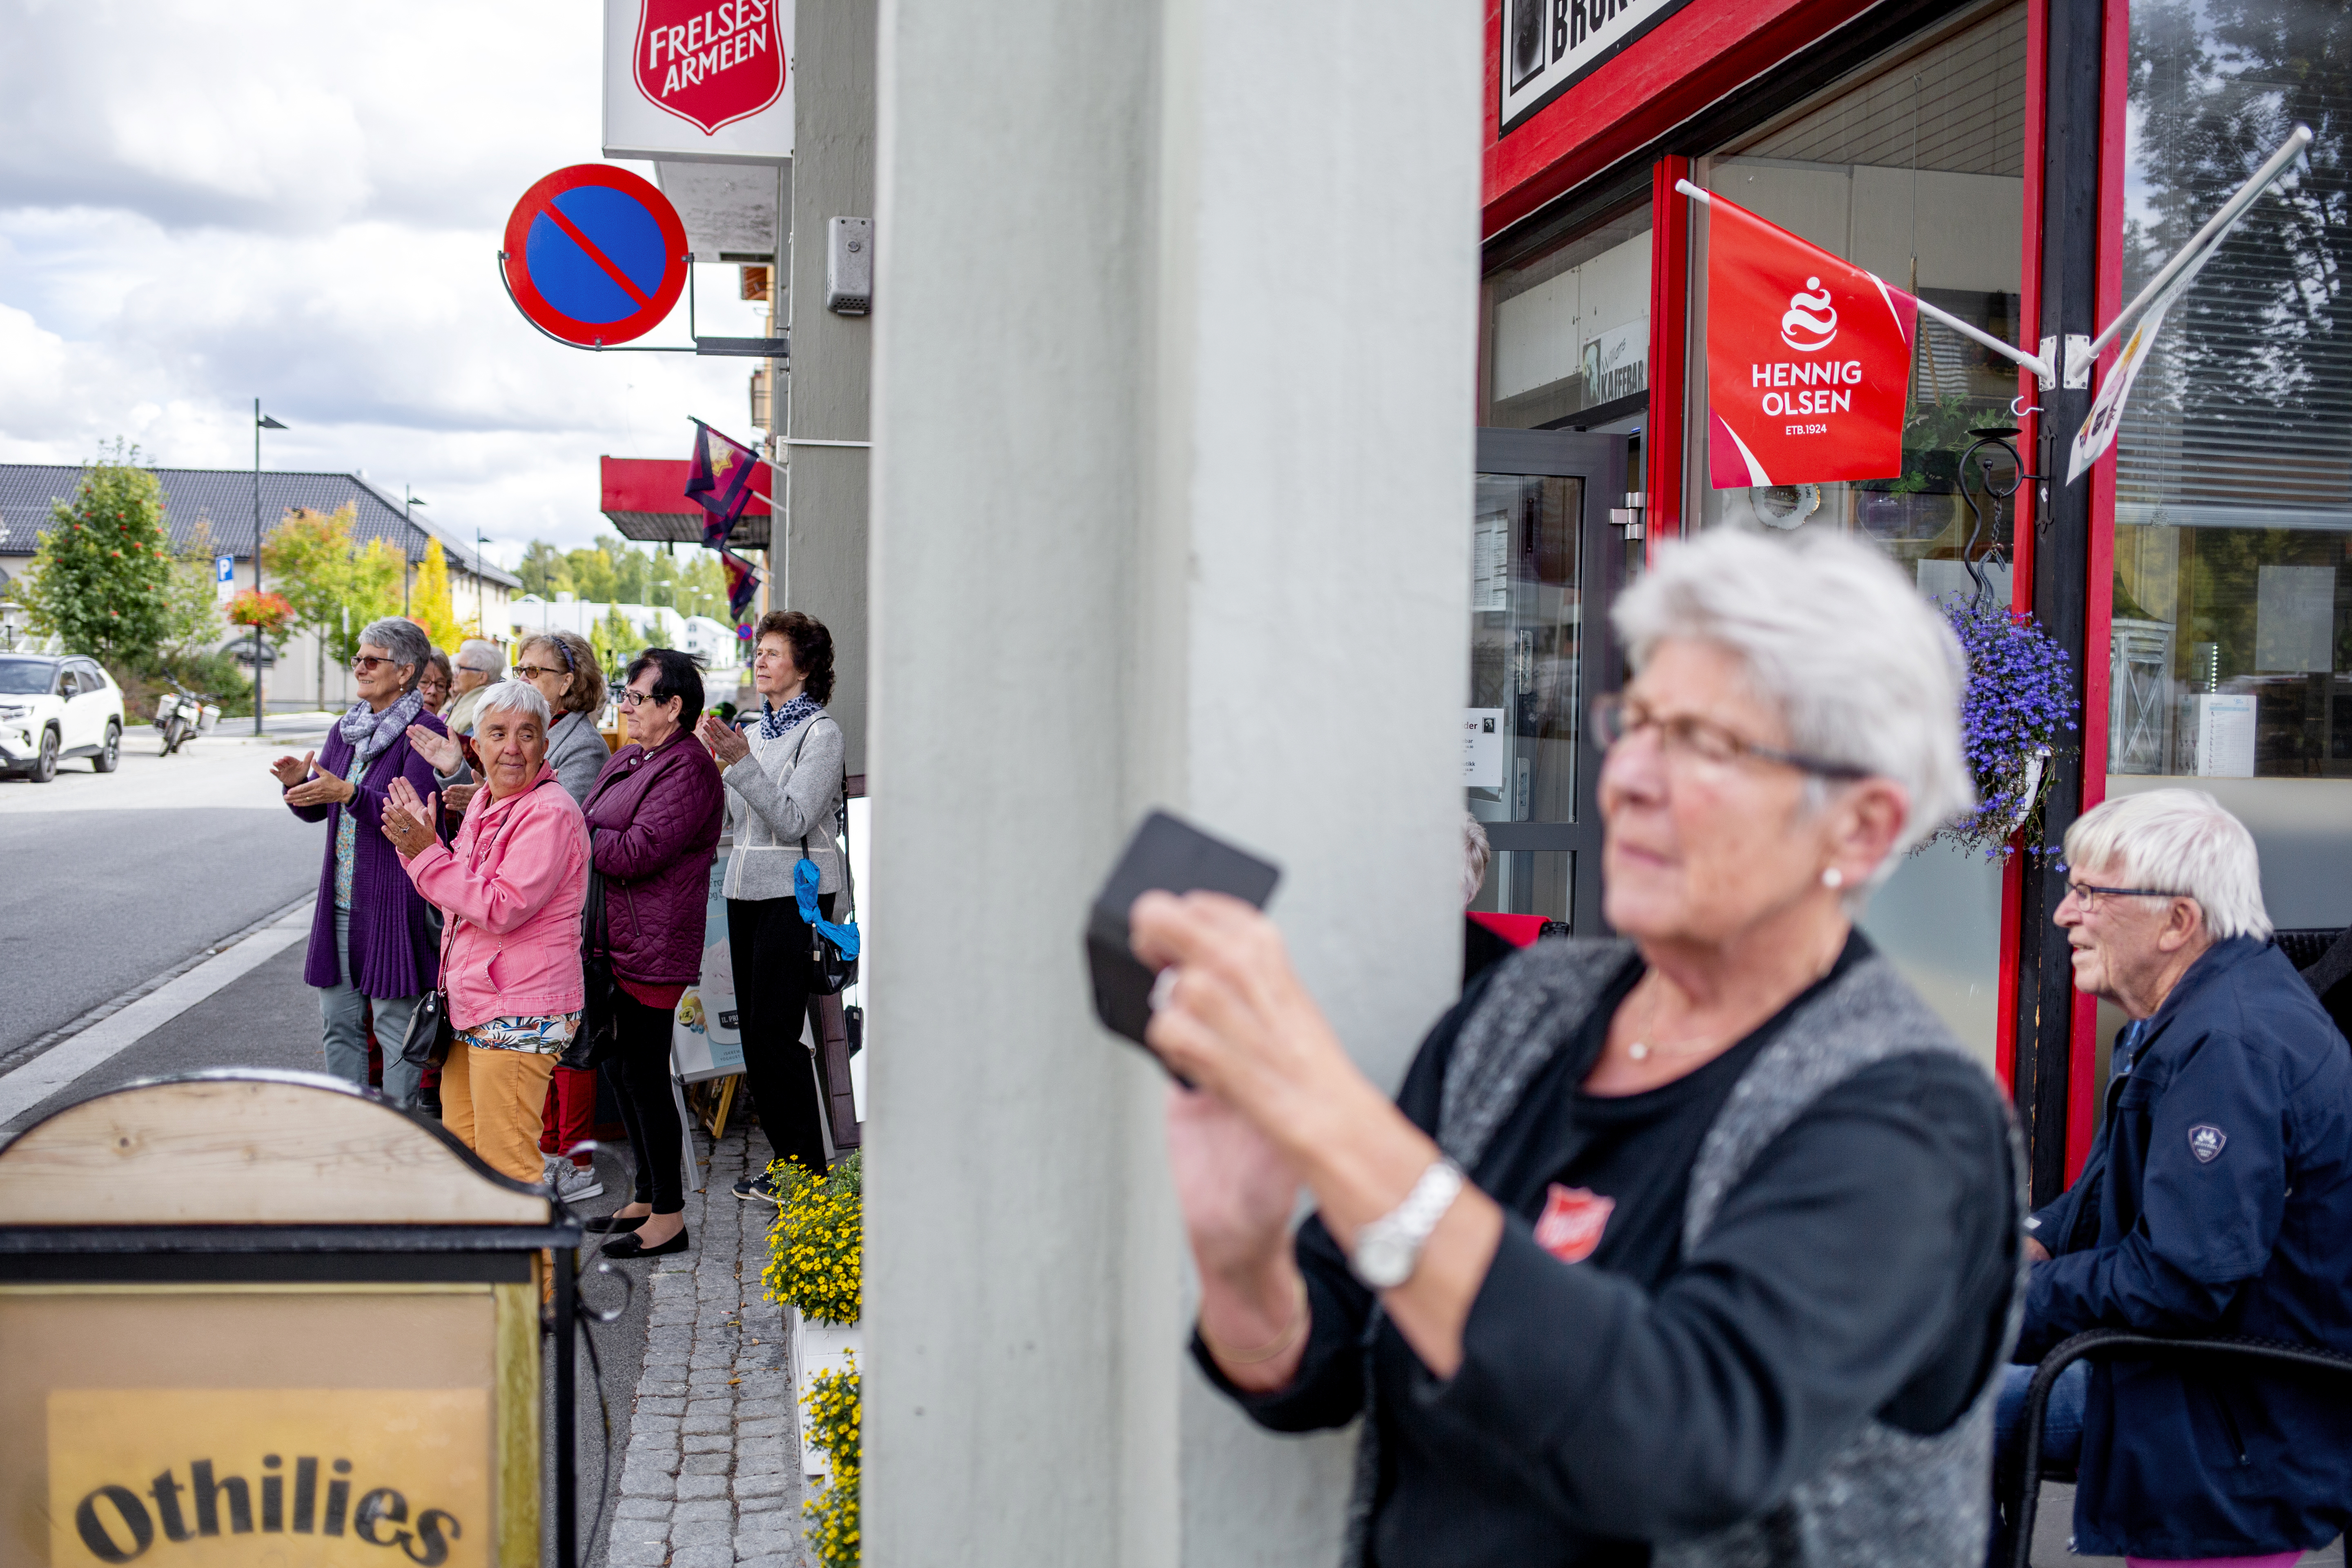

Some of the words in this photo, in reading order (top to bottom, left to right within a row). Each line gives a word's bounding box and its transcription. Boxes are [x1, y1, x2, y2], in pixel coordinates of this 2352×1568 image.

[661, 22, 767, 98] ARMEEN
[1601, 360, 1644, 404] KAFFEBAR
[1753, 361, 1862, 388] HENNIG
[1762, 390, 1851, 416] OLSEN
[1786, 424, 1827, 435] ETB.1924
[220, 559, 230, 580] P
[75, 1454, 462, 1568] Othilies
